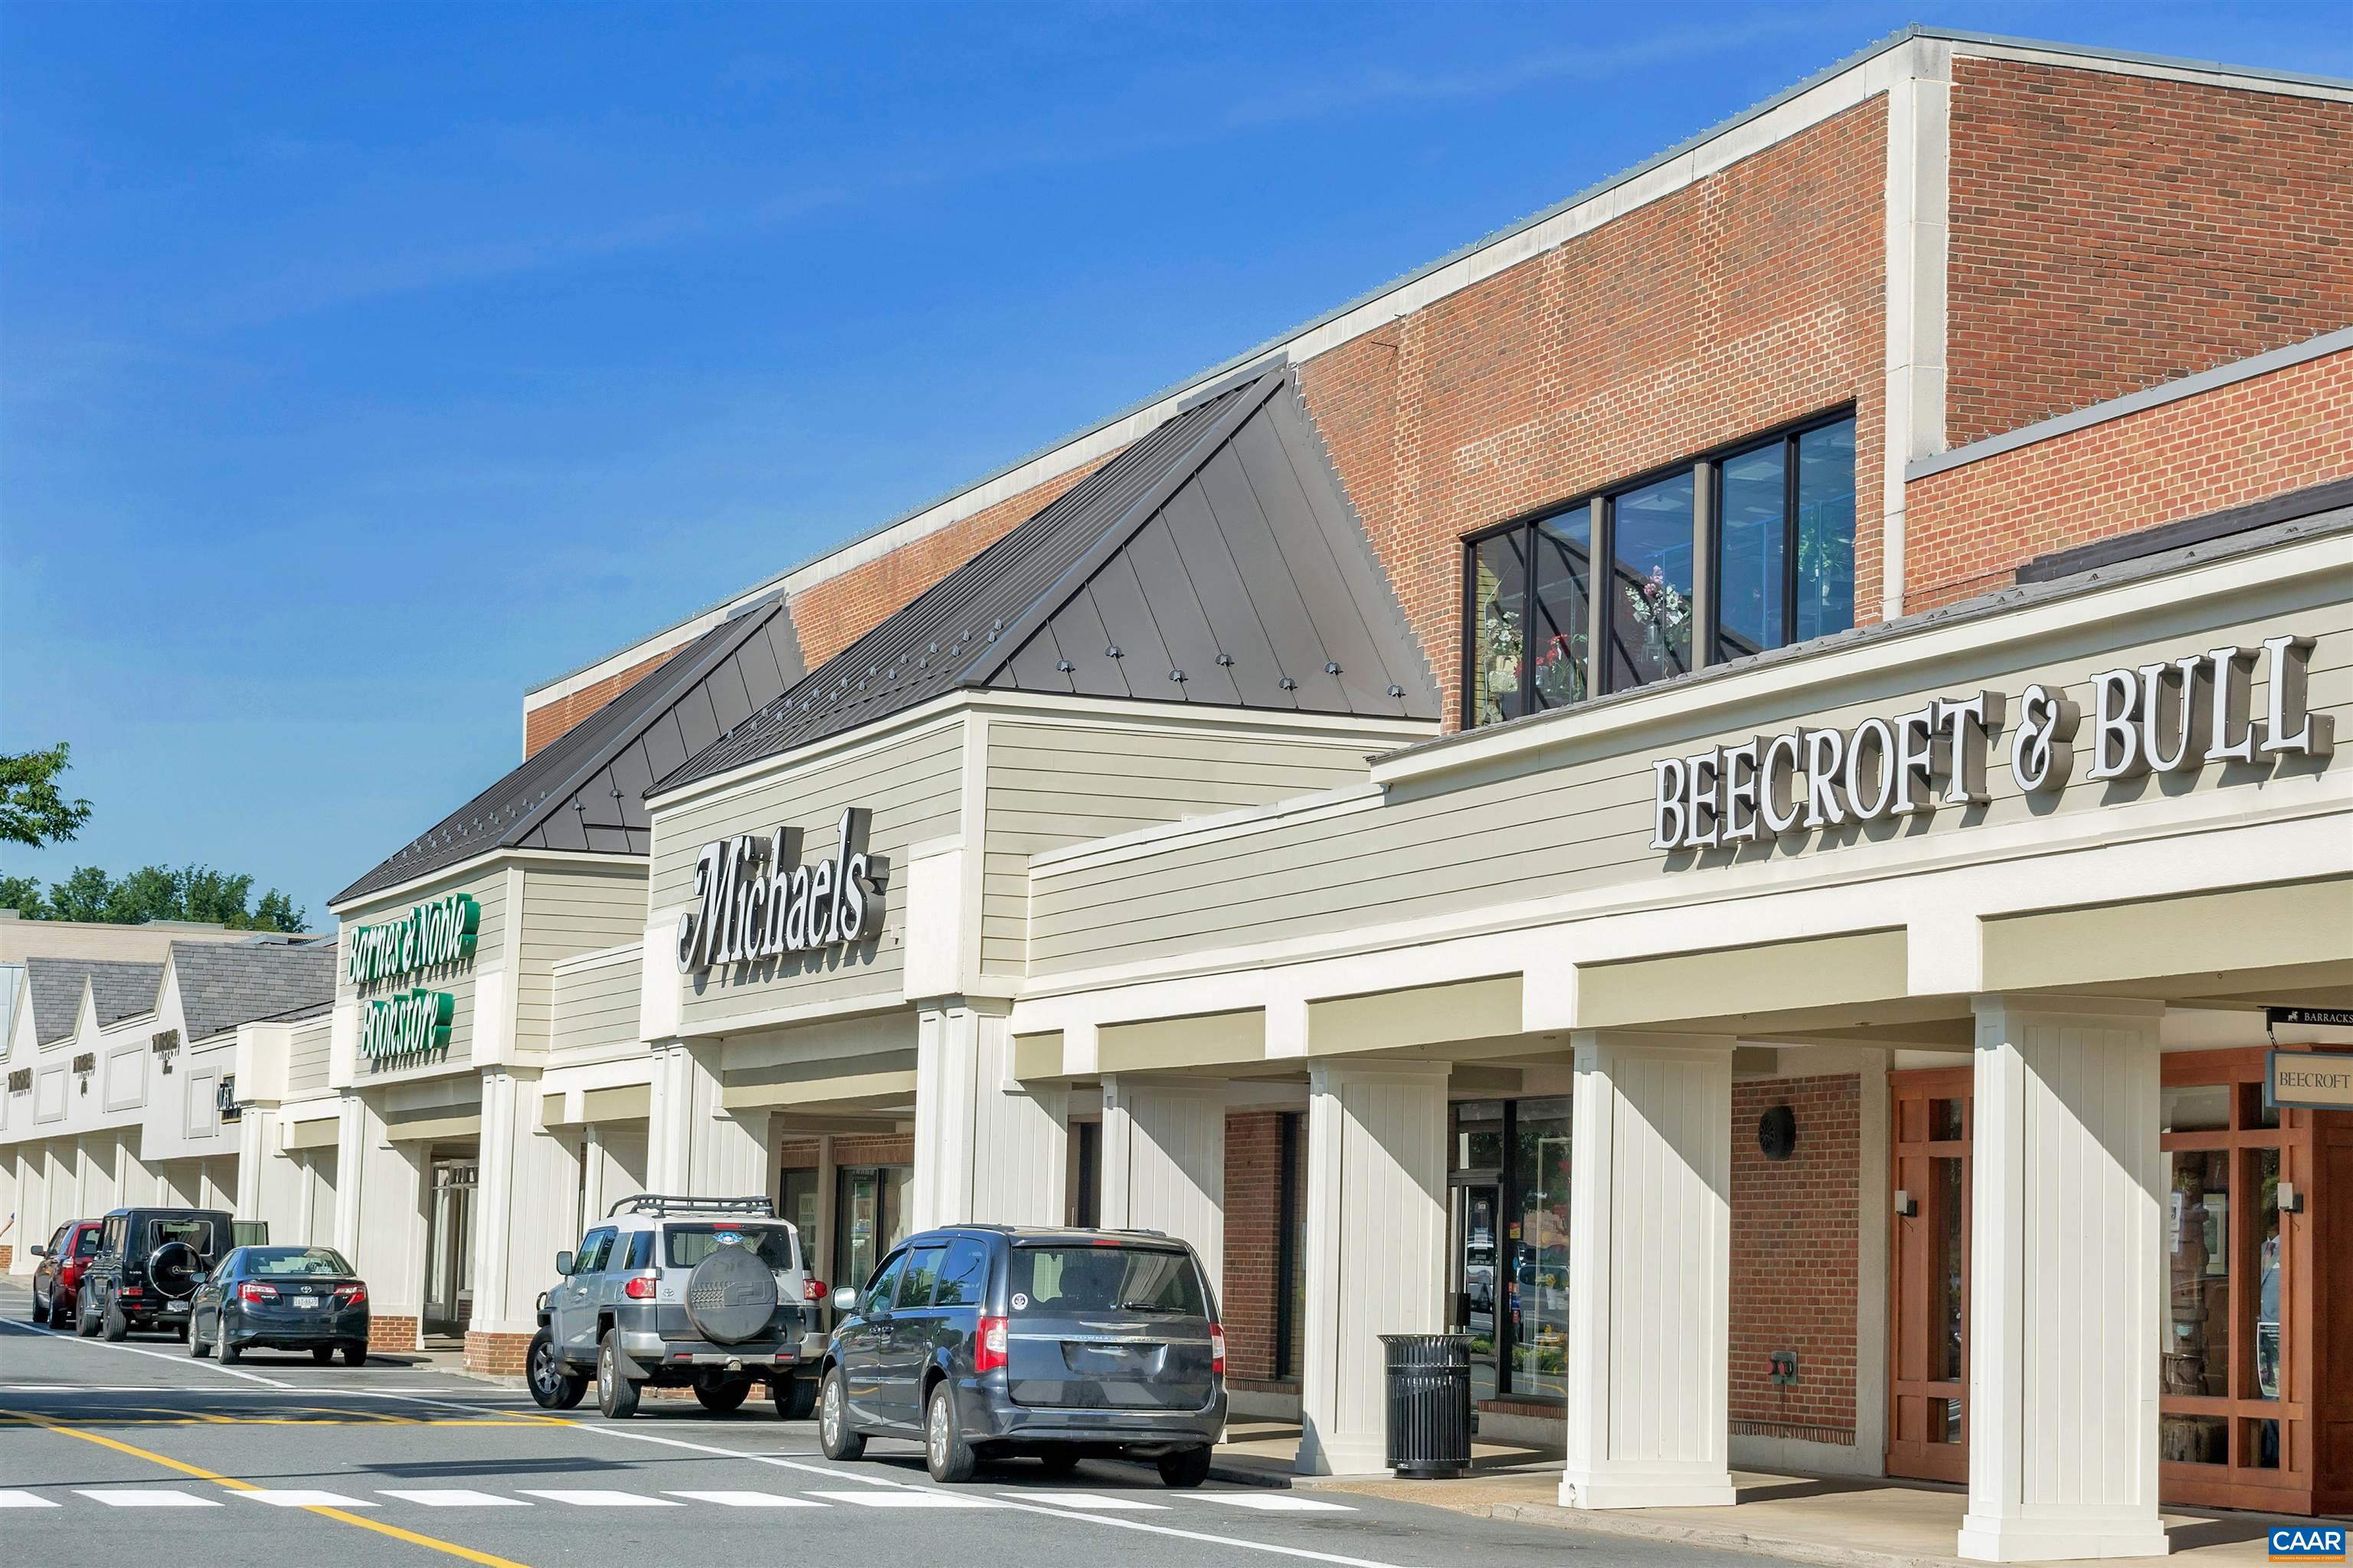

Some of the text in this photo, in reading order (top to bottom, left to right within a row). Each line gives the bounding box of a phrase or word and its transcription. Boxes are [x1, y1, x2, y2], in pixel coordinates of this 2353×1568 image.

[1649, 634, 2322, 850] BEECROFT & BULL
[676, 807, 882, 975] Michaels
[344, 892, 473, 986] Barnes & Noble
[358, 987, 448, 1060] Bookstore
[2303, 1012, 2353, 1023] BARRACKS
[2279, 1072, 2351, 1088] BEECROFT
